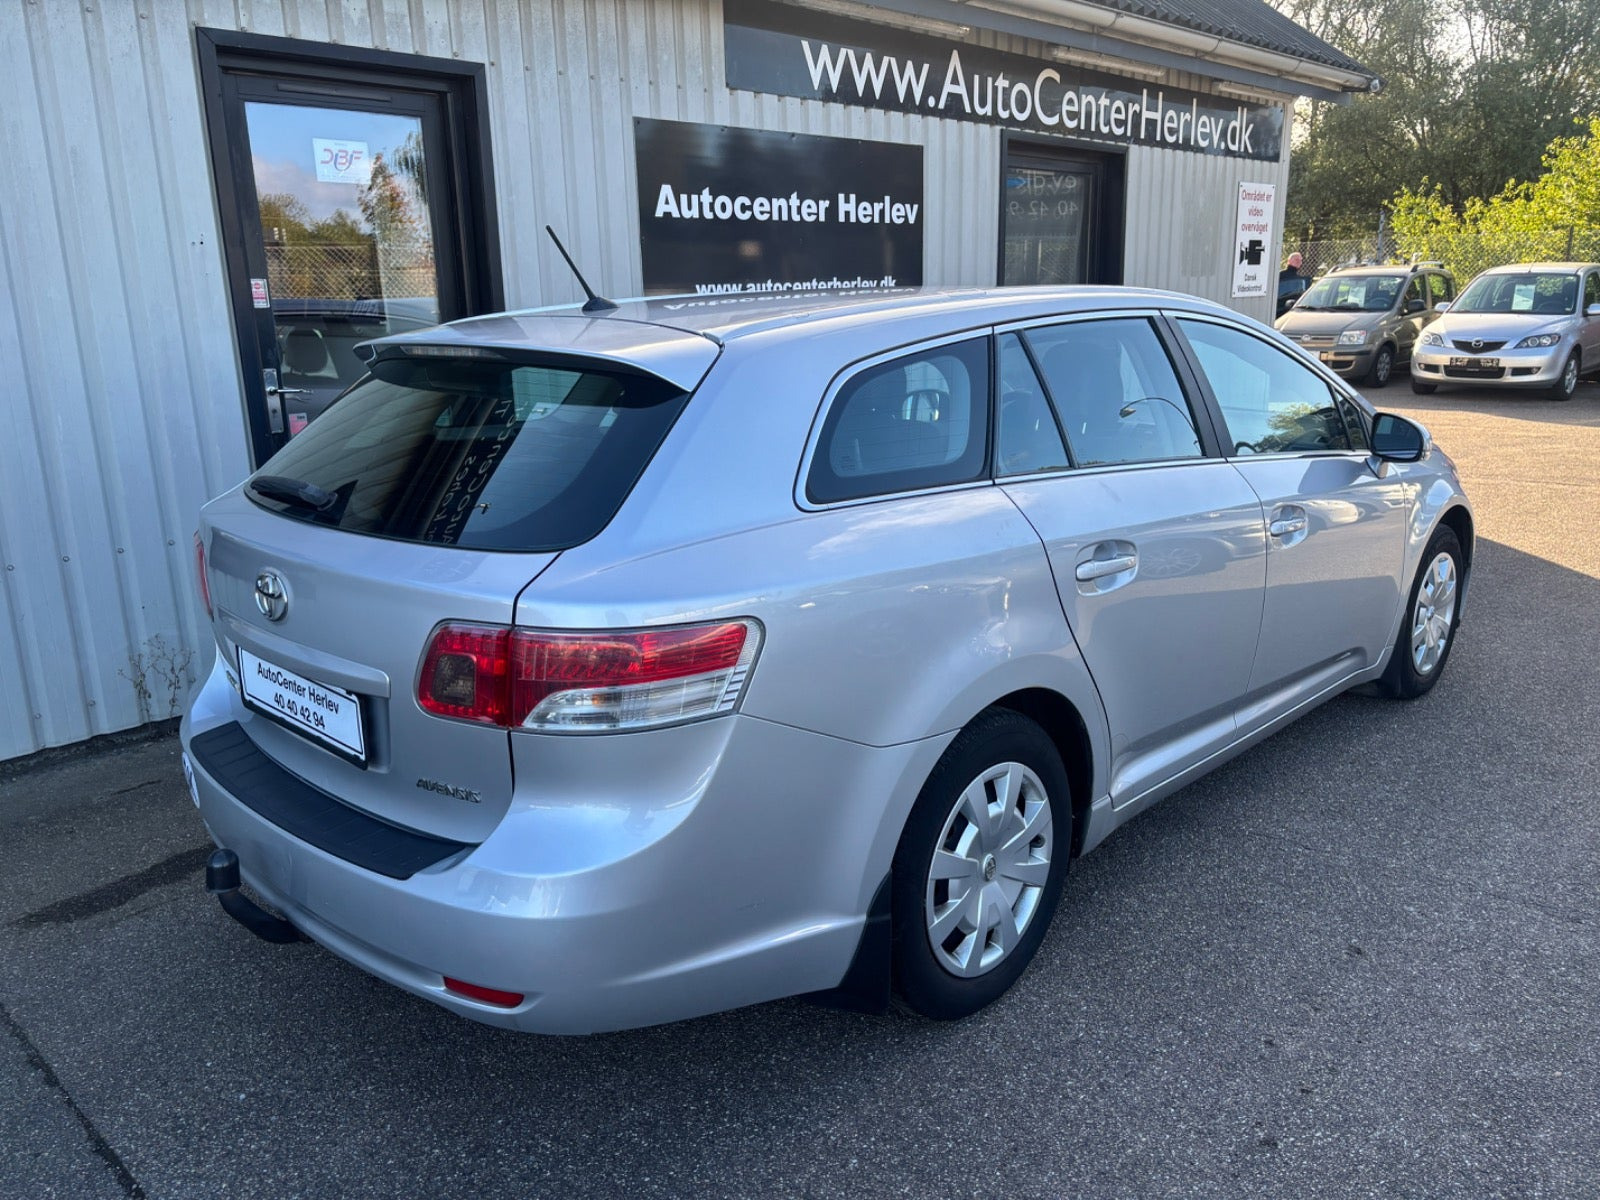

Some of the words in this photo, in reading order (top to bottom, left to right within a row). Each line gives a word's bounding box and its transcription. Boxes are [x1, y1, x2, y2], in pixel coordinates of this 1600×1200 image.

[801, 40, 1254, 154] www.AutoCenterHerlev.dk
[655, 184, 830, 222] Autocenter
[838, 193, 919, 224] Herlev
[1241, 189, 1266, 202] Området
[1266, 193, 1273, 203] er
[1248, 206, 1264, 217] video
[1241, 221, 1268, 234] overvåget
[695, 275, 896, 296] wwwautocenterherlevdk
[1244, 273, 1257, 282] Dansk
[257, 662, 307, 697] AutoCenter
[308, 686, 340, 715] Herlev
[274, 692, 285, 709] 40
[286, 698, 298, 716] 40
[300, 705, 311, 723] 42
[312, 711, 325, 729] 94
[416, 778, 482, 803] AVENSIS
